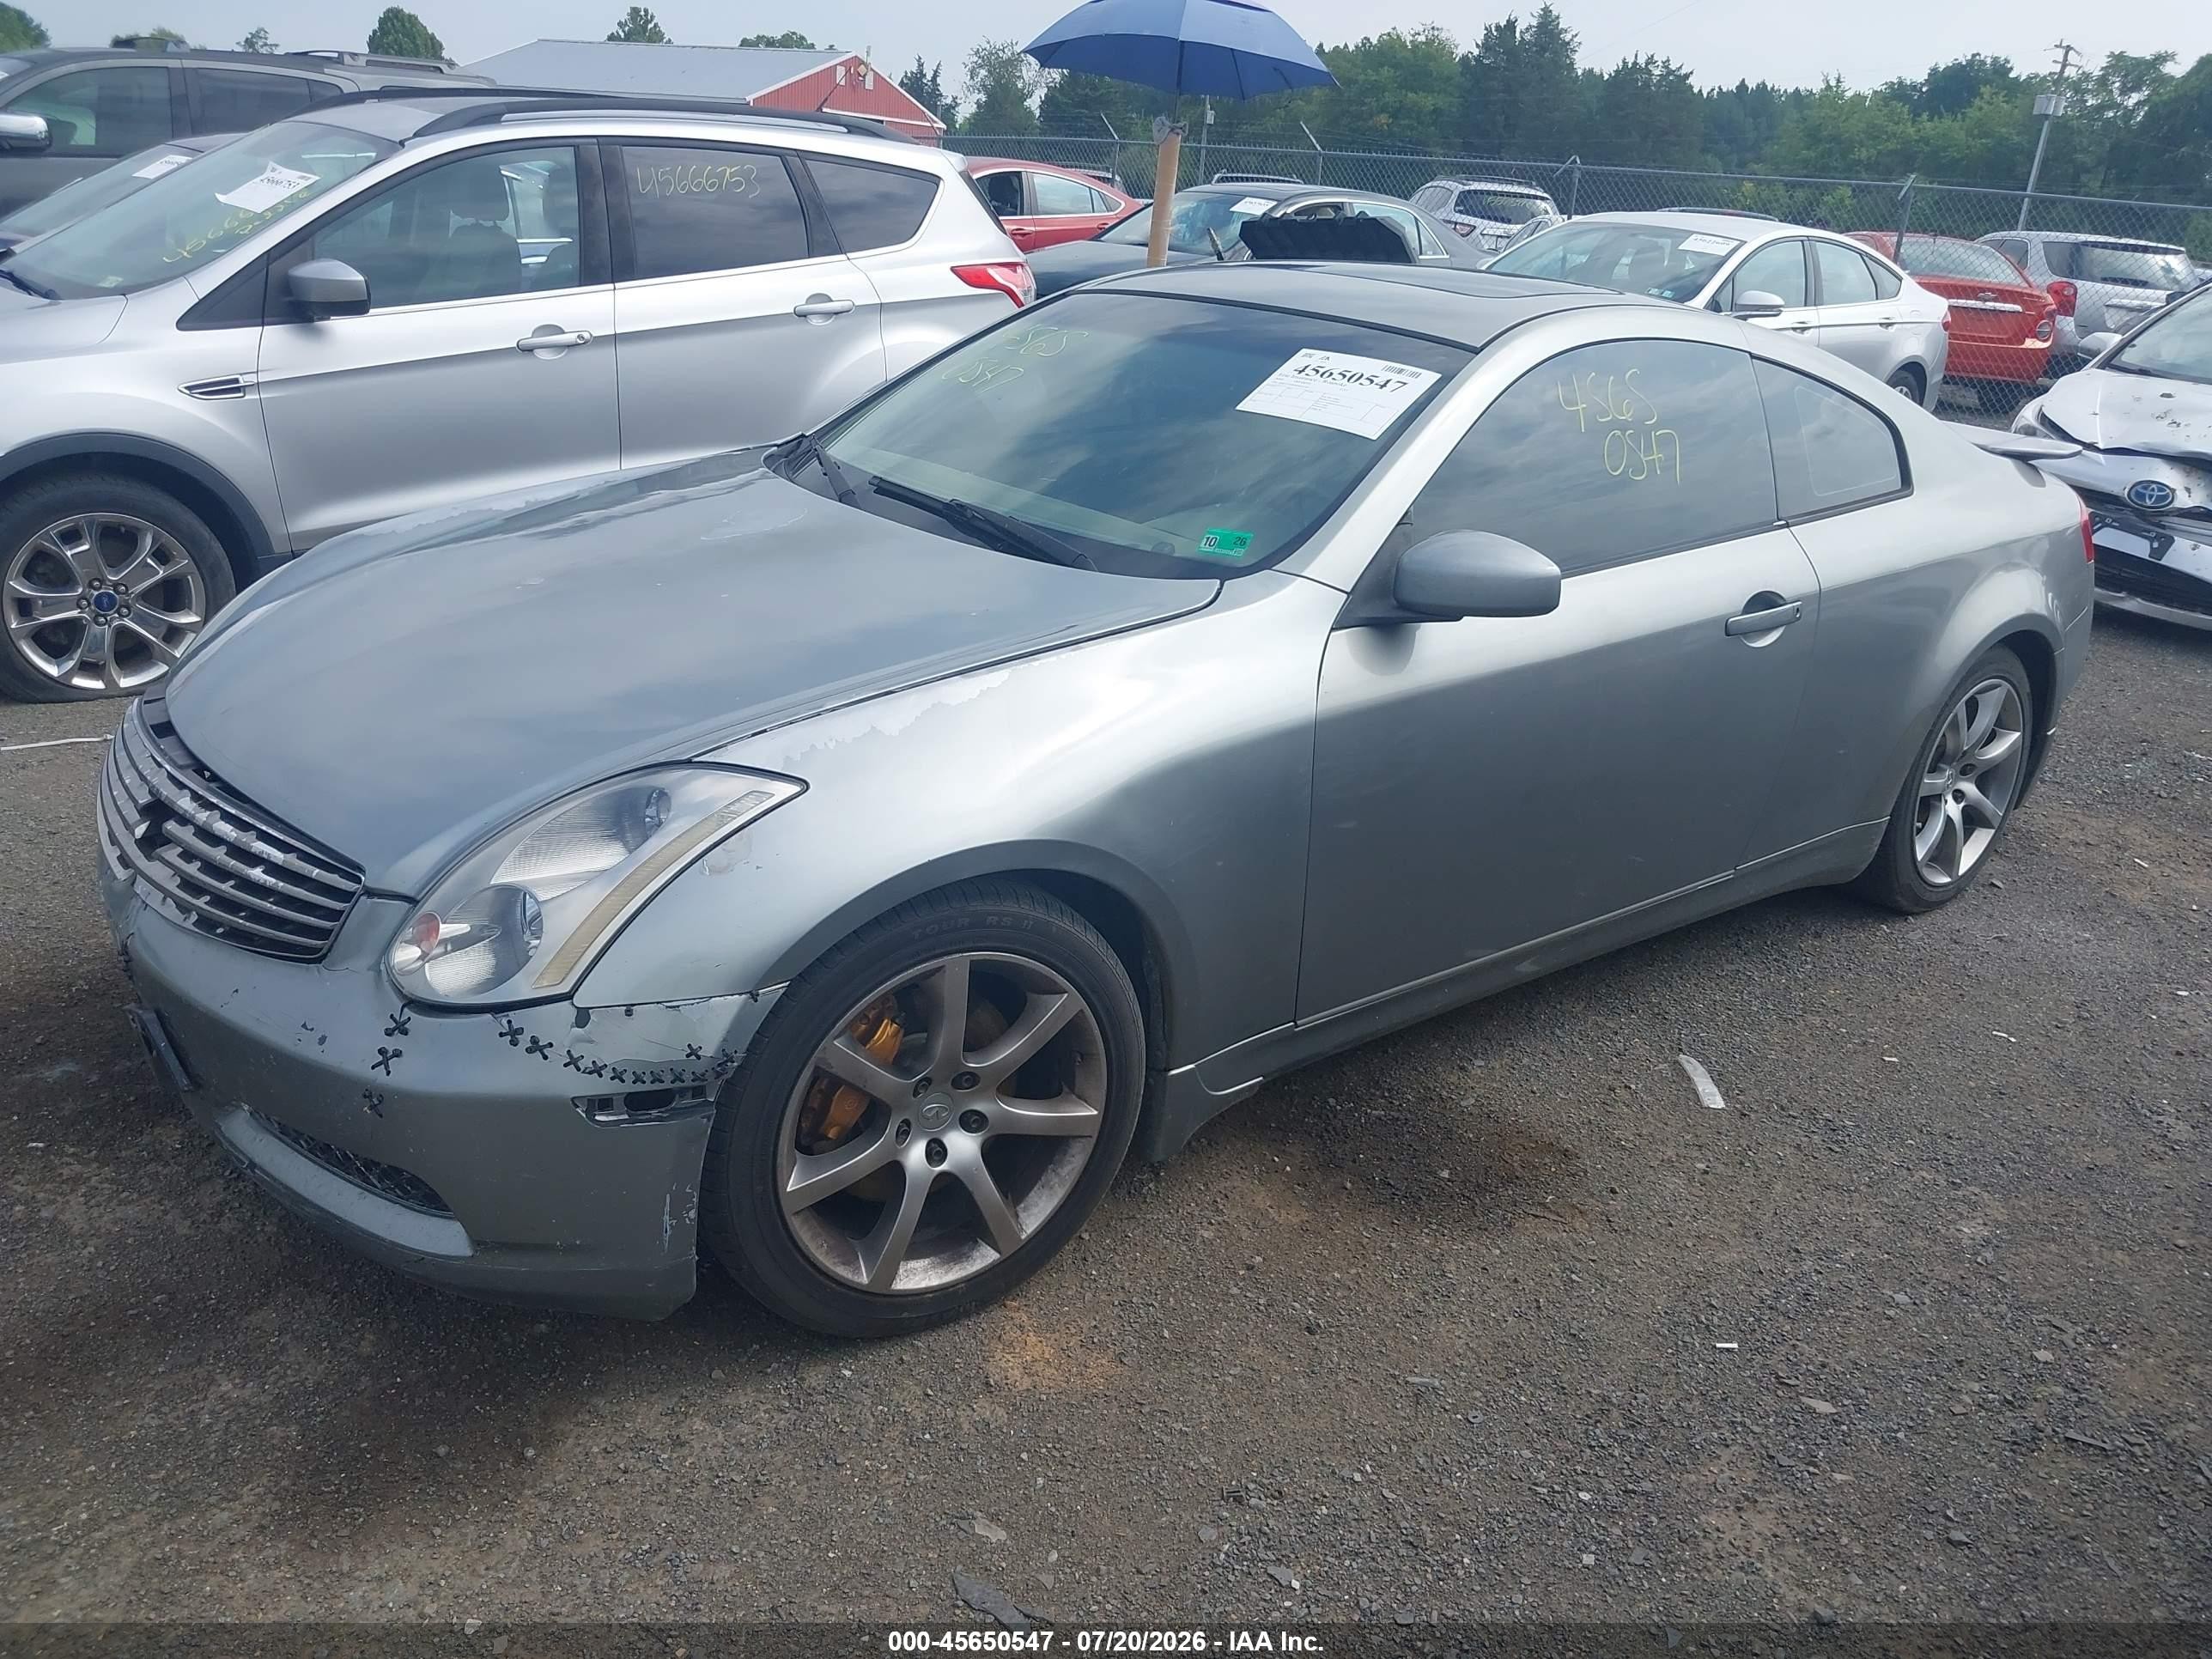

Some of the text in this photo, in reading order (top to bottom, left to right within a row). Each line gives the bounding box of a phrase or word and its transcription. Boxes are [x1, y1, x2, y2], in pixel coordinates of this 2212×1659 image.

[636, 164, 761, 199] 45666753
[1293, 364, 1409, 392] 45650547
[1558, 368, 1658, 434] 4565
[1604, 429, 1681, 487] 0547
[1203, 536, 1247, 547] 10 26
[912, 916, 971, 941] TOUR
